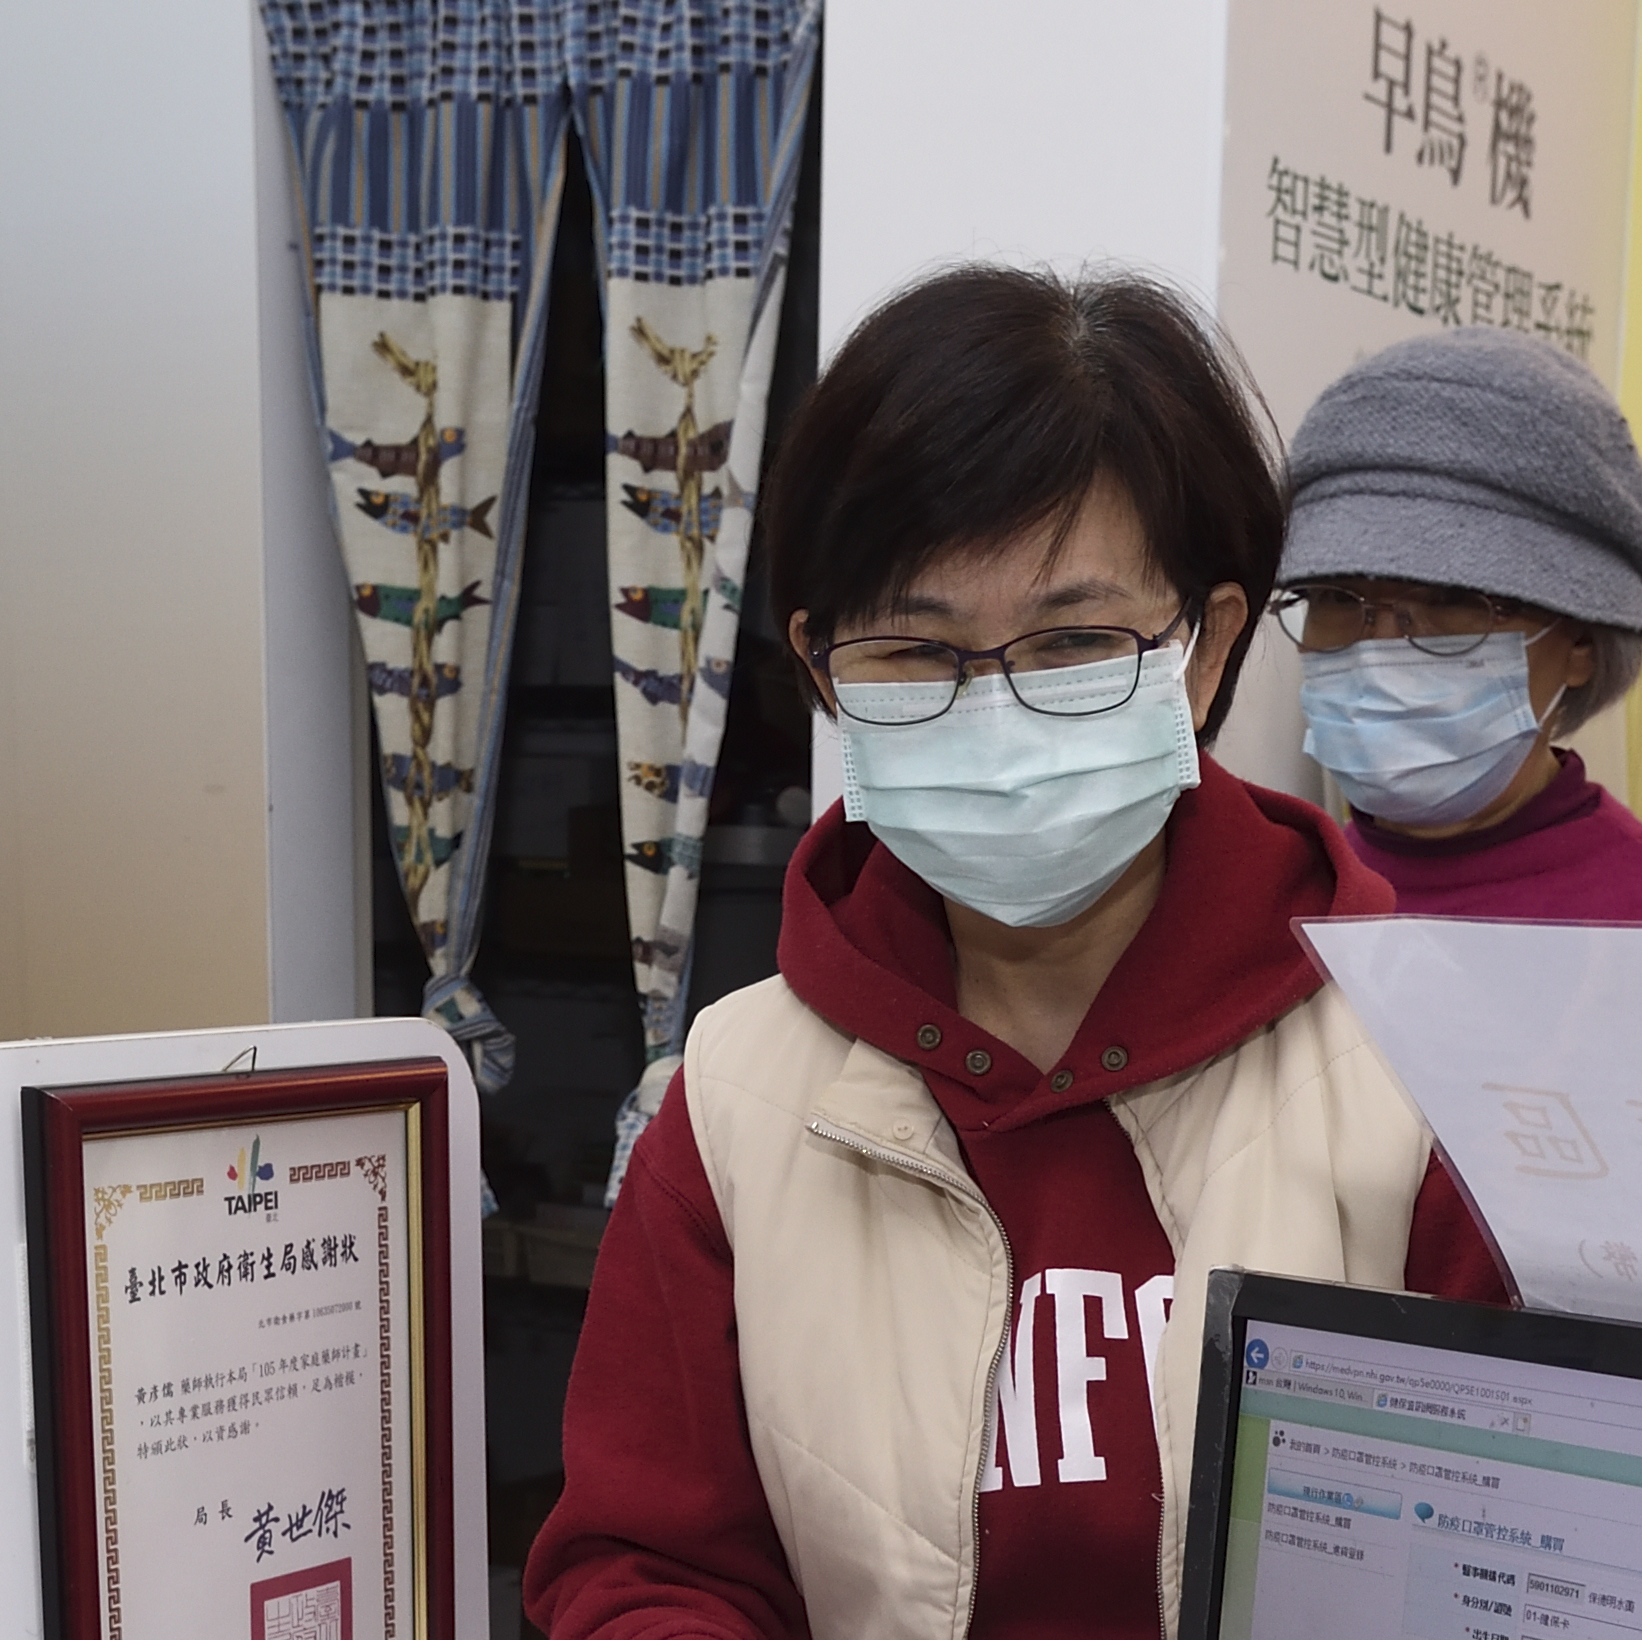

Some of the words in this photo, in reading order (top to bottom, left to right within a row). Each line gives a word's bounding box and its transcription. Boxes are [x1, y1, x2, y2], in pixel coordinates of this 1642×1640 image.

[224, 1191, 278, 1215] TAIPEI
[125, 1234, 359, 1304] 臺北市政府衛生局感謝狀
